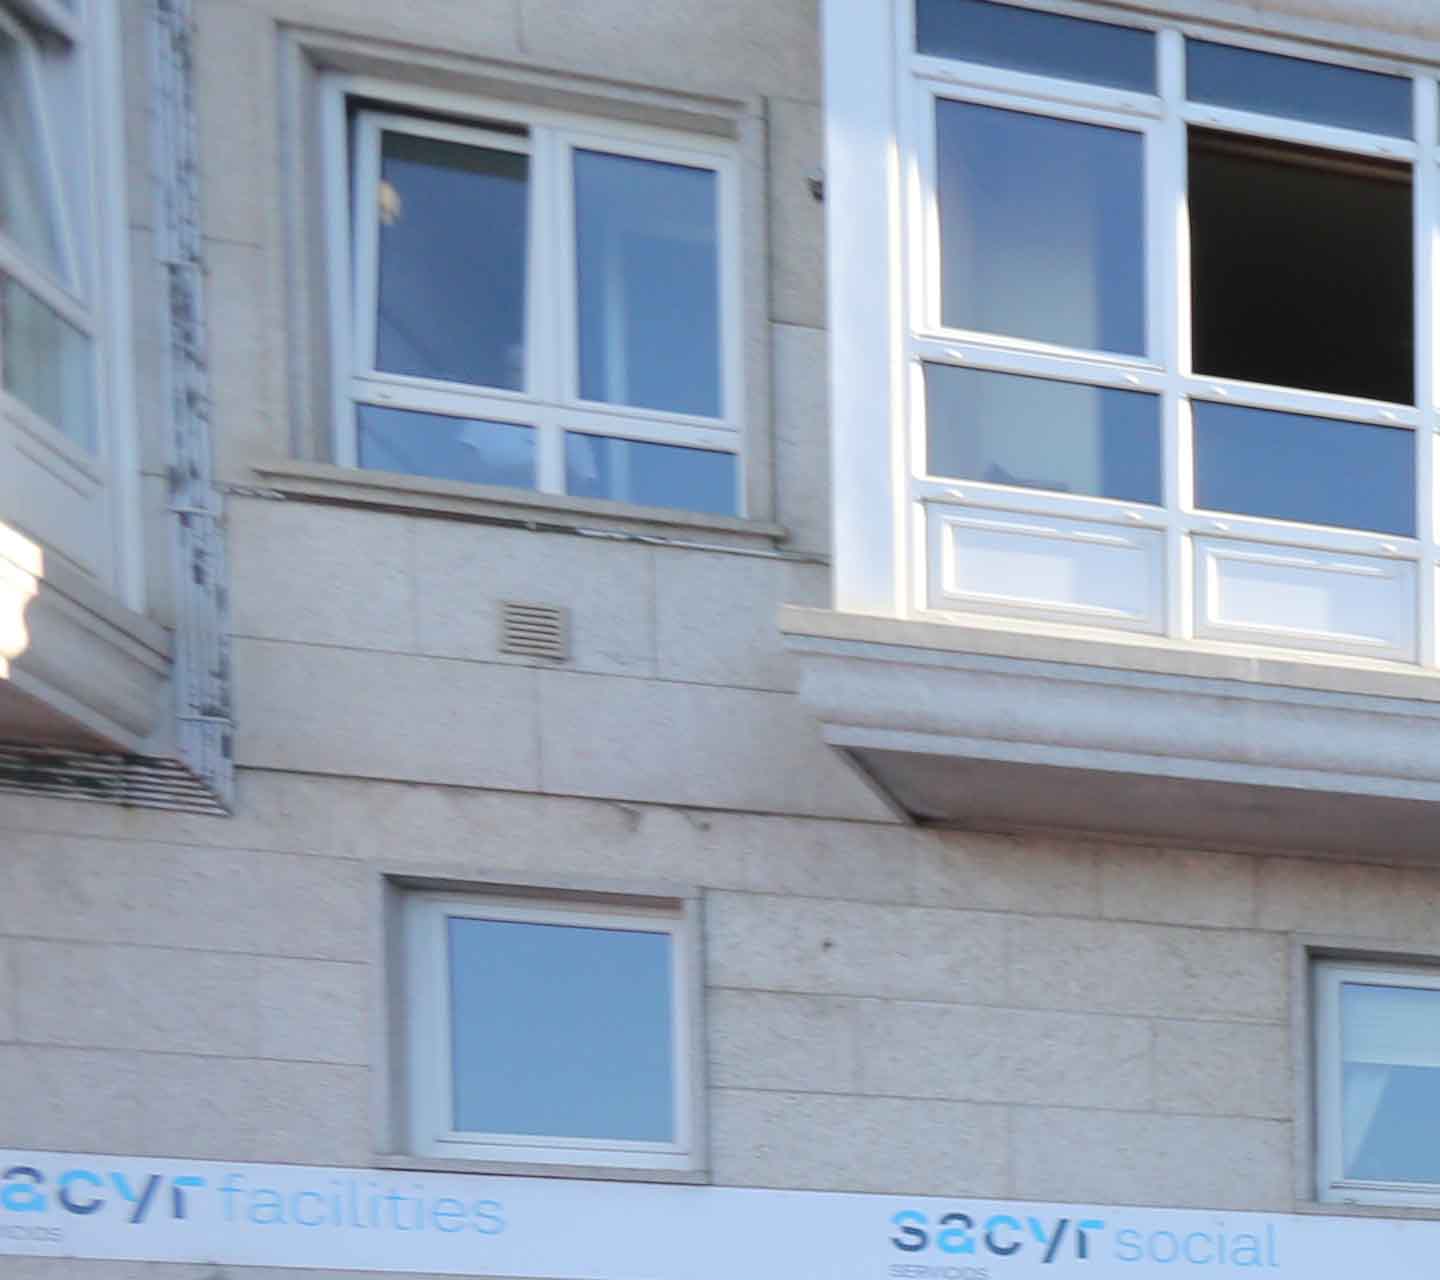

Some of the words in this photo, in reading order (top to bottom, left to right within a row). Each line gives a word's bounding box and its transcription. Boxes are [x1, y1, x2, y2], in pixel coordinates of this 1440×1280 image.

[216, 1171, 507, 1236] facilities
[889, 1209, 1106, 1264] sacyr
[1115, 1223, 1280, 1268] social
